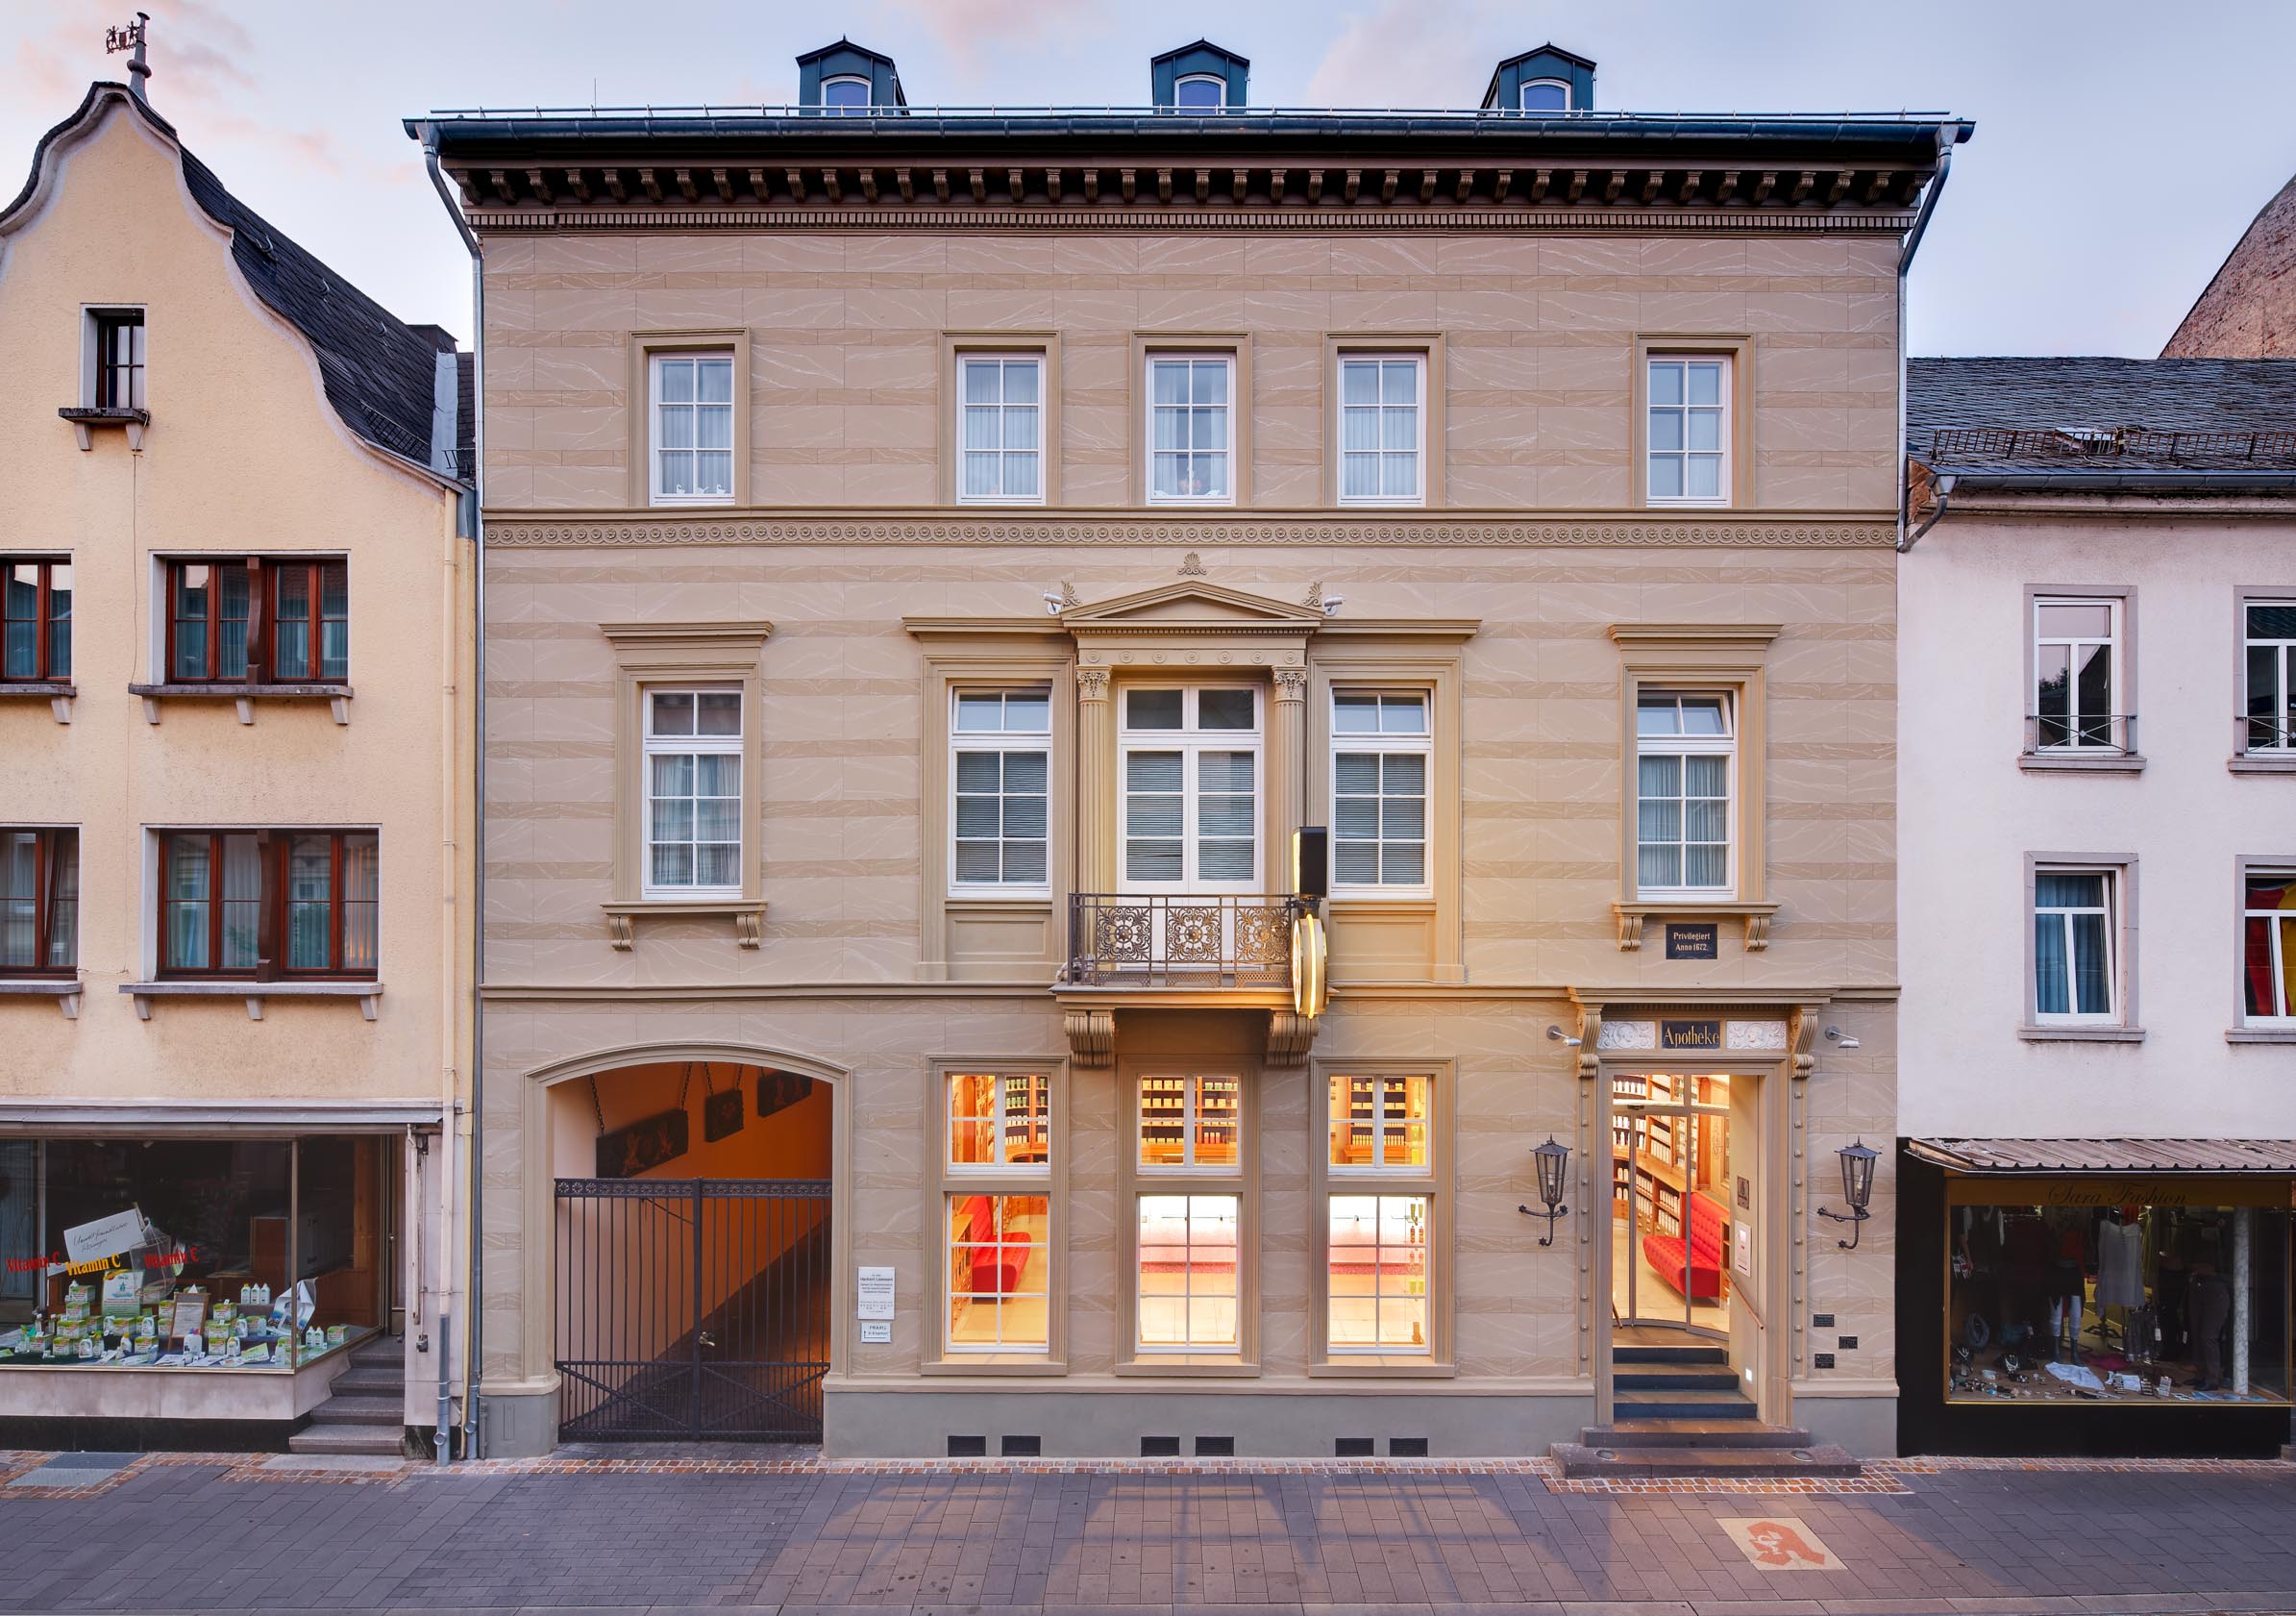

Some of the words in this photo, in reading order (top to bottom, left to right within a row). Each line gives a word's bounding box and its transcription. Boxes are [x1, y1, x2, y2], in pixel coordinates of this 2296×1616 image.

[1673, 932, 1711, 941] Privilegiert
[1662, 1025, 1719, 1048] Apotheke
[2109, 1181, 2188, 1204] Fashion
[7, 1255, 50, 1274] Vitamin
[51, 1251, 62, 1267] C
[64, 1256, 110, 1276] Vitamin
[111, 1253, 121, 1268] C
[144, 1252, 186, 1269] Vitamin
[189, 1247, 200, 1262] C
